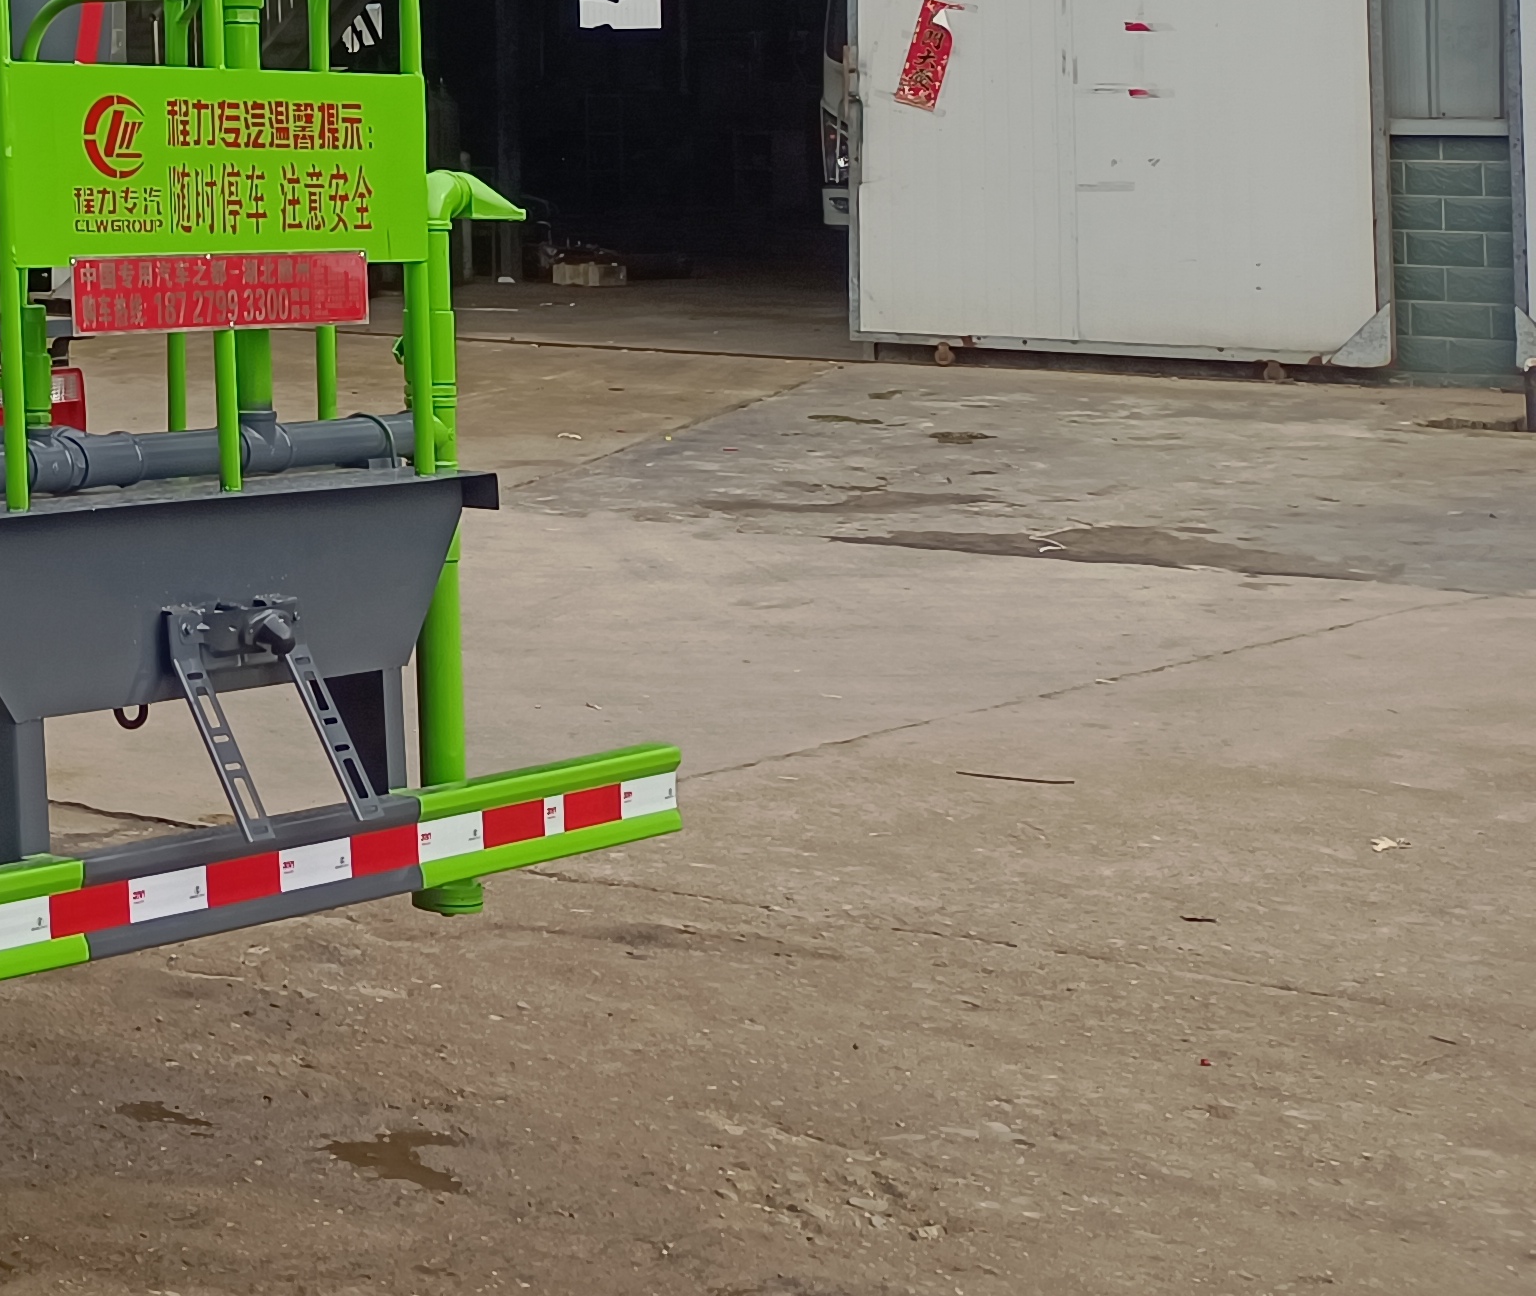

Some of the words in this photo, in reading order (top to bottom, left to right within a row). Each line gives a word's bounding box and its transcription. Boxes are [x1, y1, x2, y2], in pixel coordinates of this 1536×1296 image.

[73, 186, 162, 215] 程力专汽
[167, 162, 268, 235] 随时停车
[280, 161, 374, 234] 注意安全
[243, 288, 289, 322] 3300
